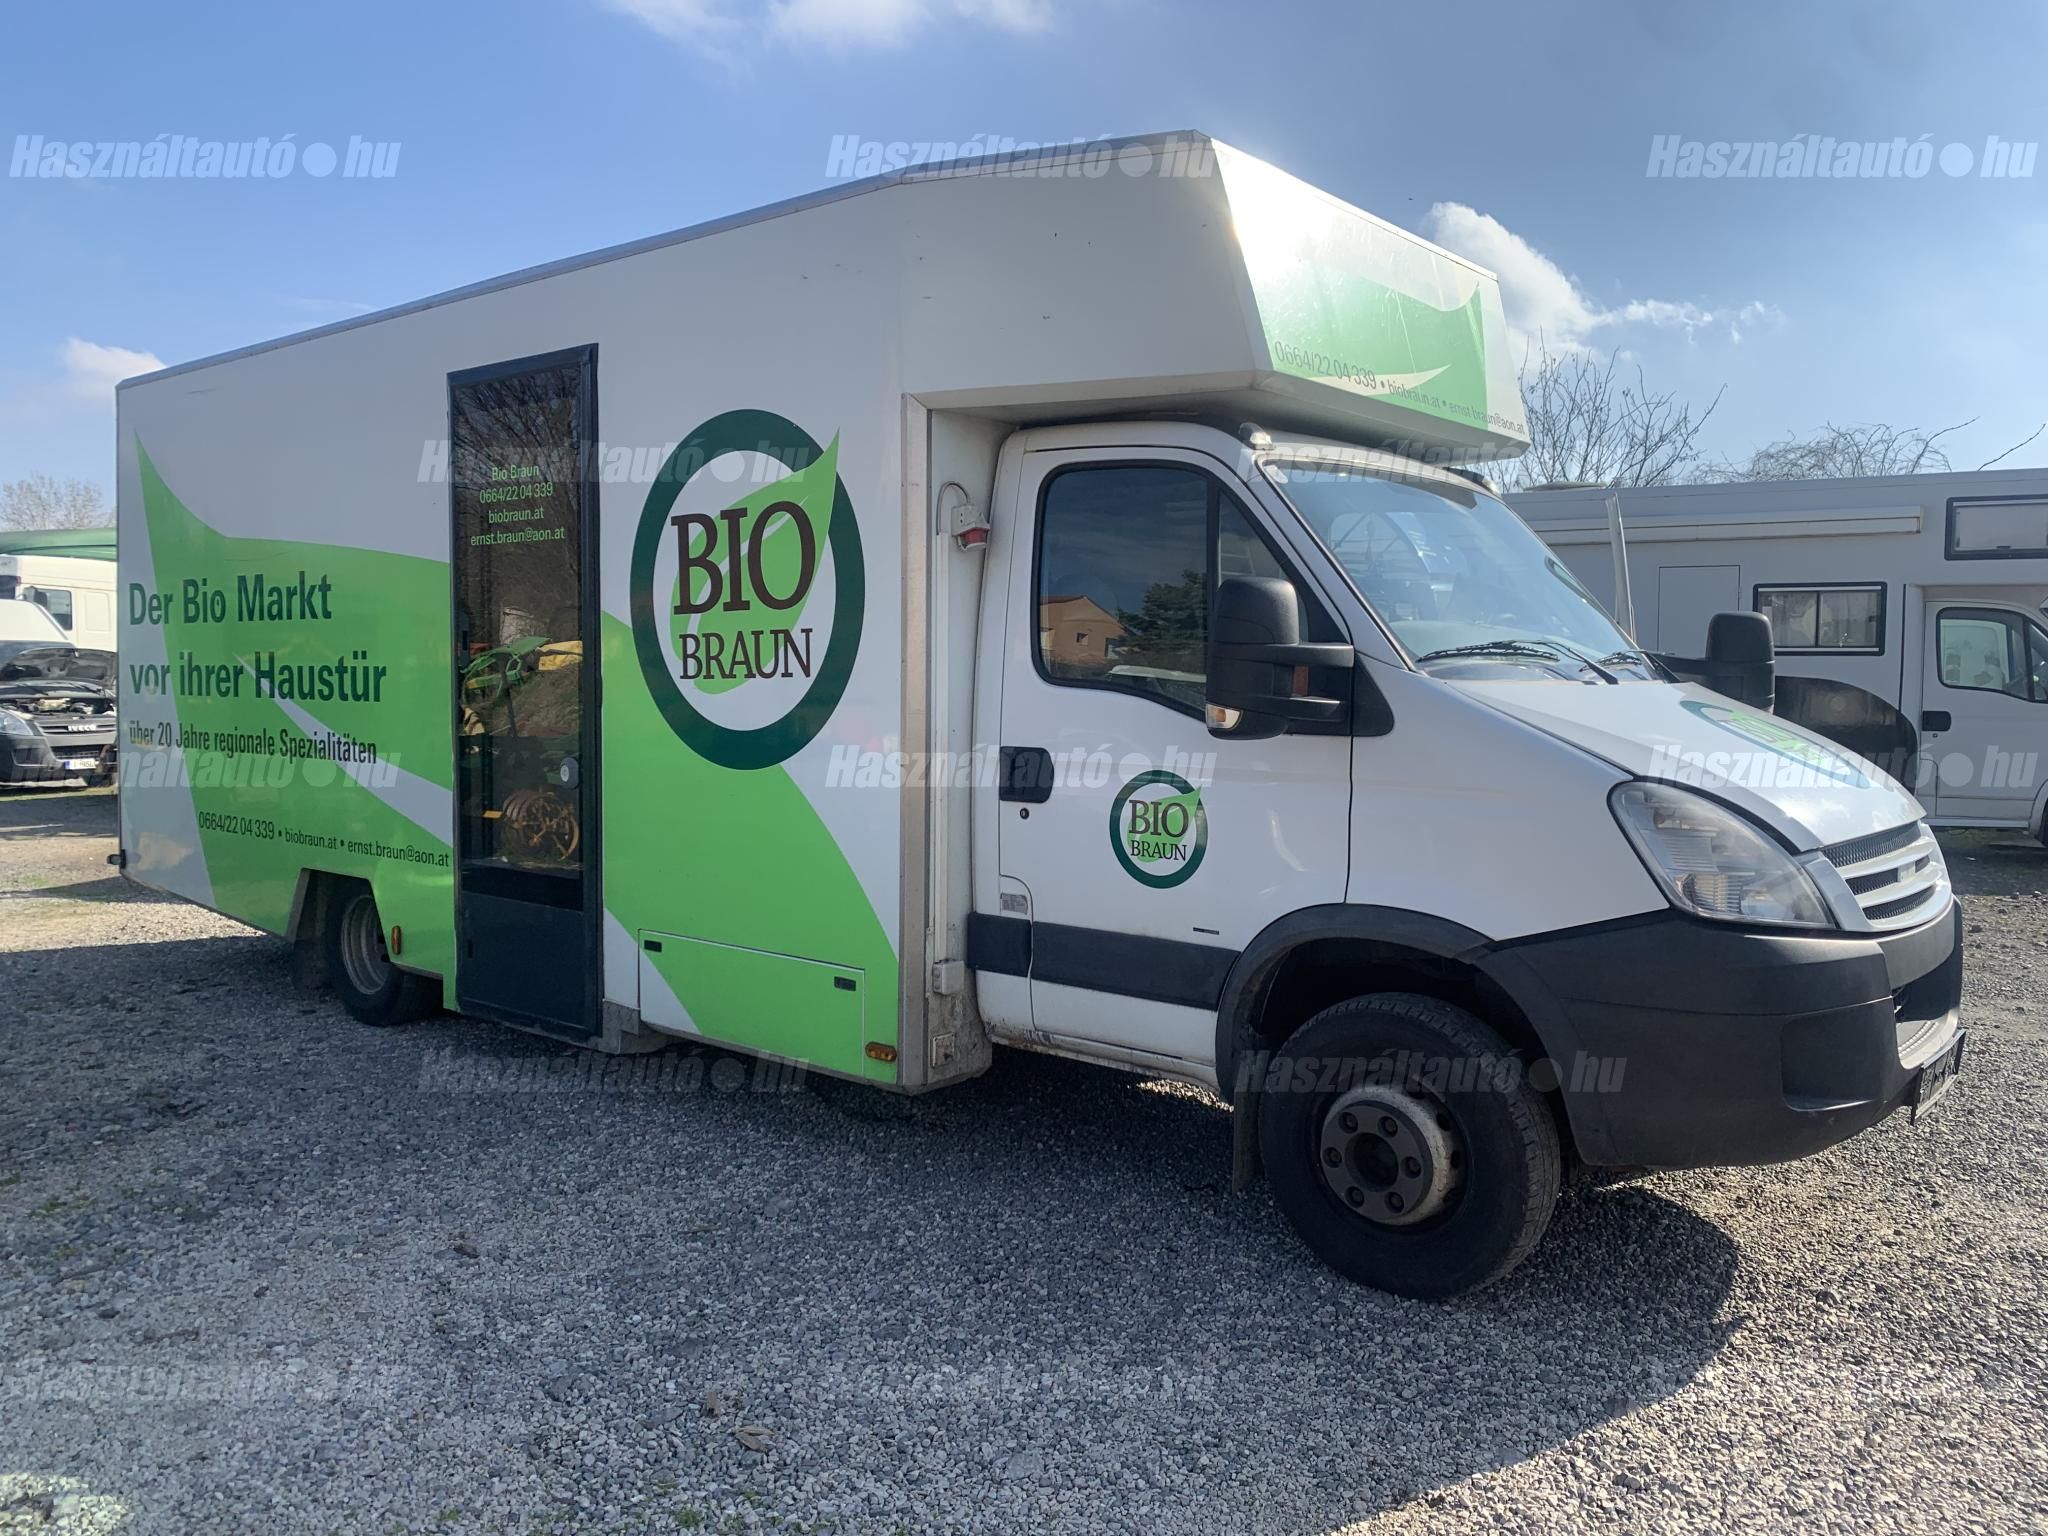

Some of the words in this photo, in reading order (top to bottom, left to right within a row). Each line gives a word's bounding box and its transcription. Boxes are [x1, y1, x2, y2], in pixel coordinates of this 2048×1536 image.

[491, 466, 508, 480] Bio
[510, 464, 540, 479] Braun
[488, 505, 545, 523] biobraun.at
[470, 526, 565, 546] ernst.braun@aon.at
[671, 501, 816, 615] BIO
[128, 582, 173, 625] Der
[182, 577, 227, 624] Bio
[236, 570, 332, 623] Markt
[679, 628, 813, 680] BRAUN
[129, 663, 171, 696] vor
[179, 651, 245, 698] ihrer
[253, 650, 388, 702] Haustür
[129, 719, 155, 745] über
[157, 721, 173, 747] 20
[175, 722, 211, 751] Jahre
[213, 725, 276, 759] regionale
[278, 727, 378, 764] Spezialitäten
[1128, 799, 1189, 838] BIO
[284, 827, 338, 850] biobraun.at
[347, 840, 450, 867] ernst.braun@aon.at
[1130, 840, 1188, 862] BRAUN
